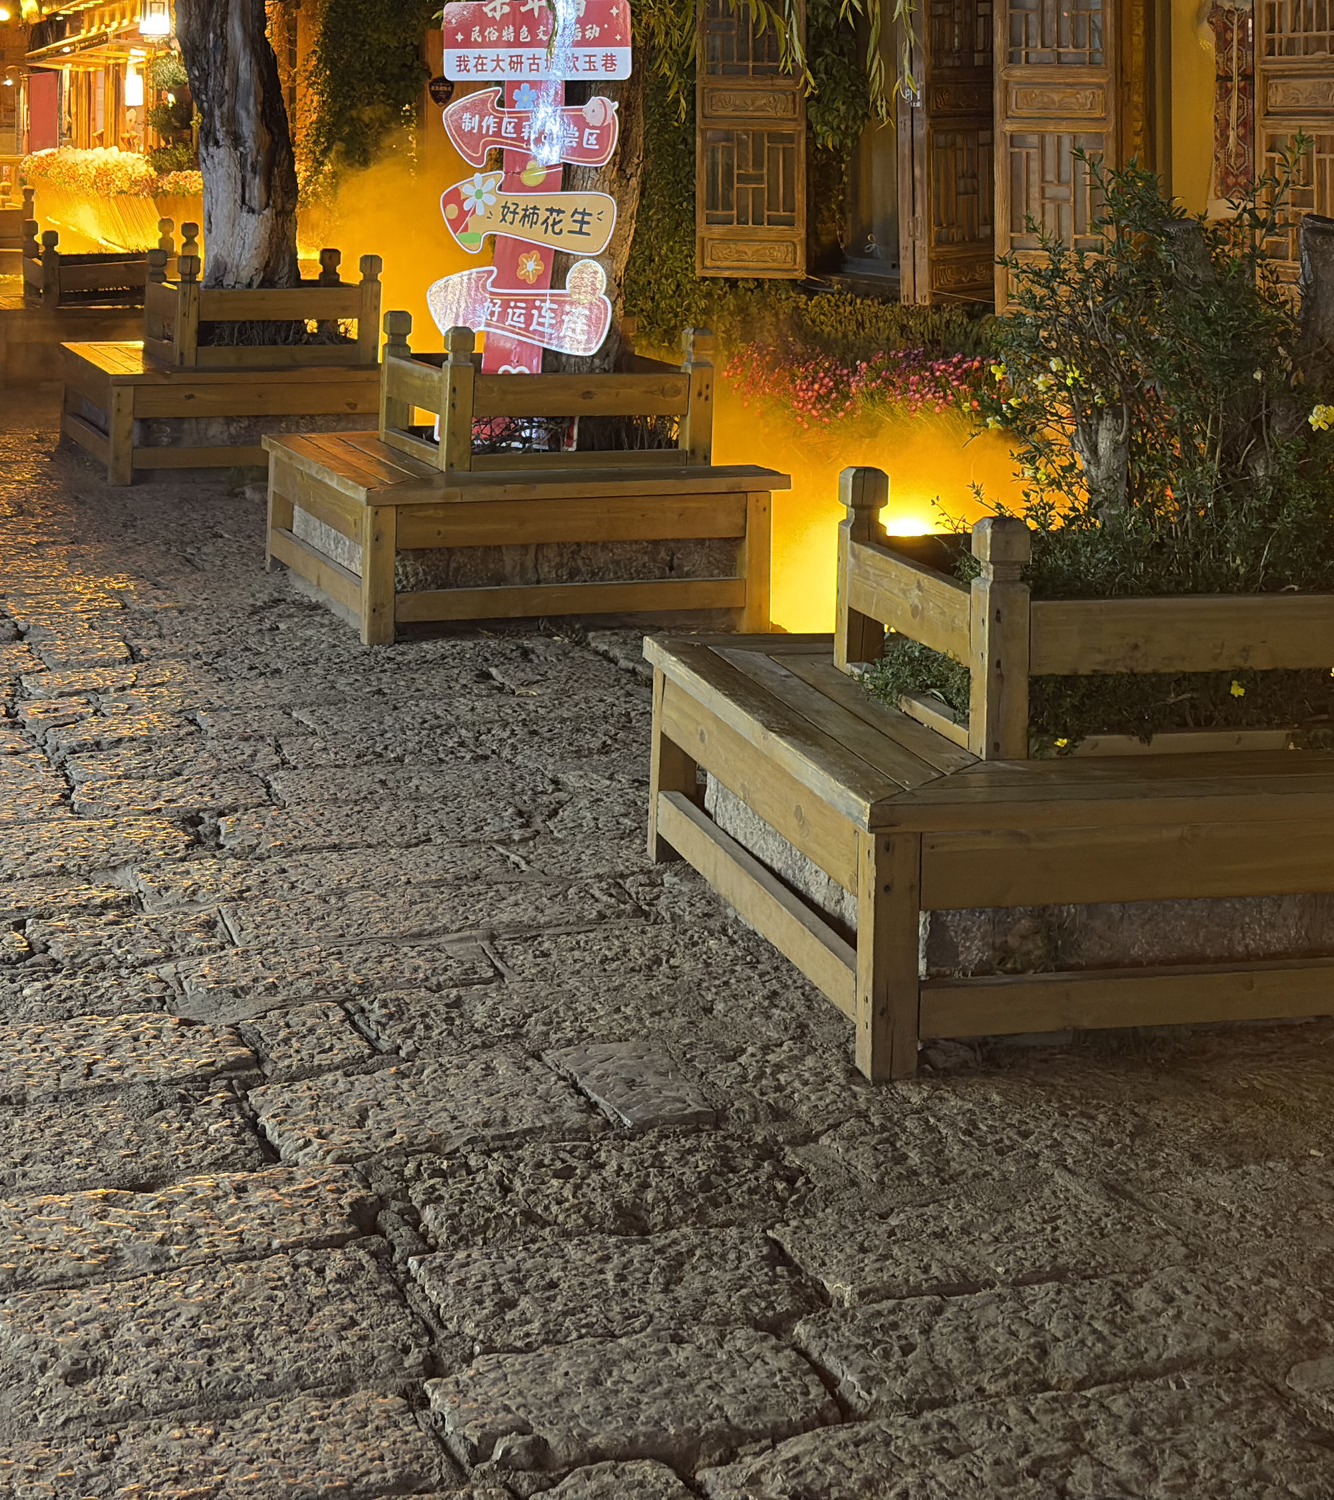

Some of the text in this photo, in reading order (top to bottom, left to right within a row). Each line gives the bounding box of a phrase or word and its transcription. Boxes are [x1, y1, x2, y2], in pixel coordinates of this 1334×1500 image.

[470, 23, 601, 43] 民俗特色文活动
[461, 112, 602, 150] 制作区和尝区
[499, 200, 594, 237] 好柿花生
[483, 298, 590, 340] 好运连连
